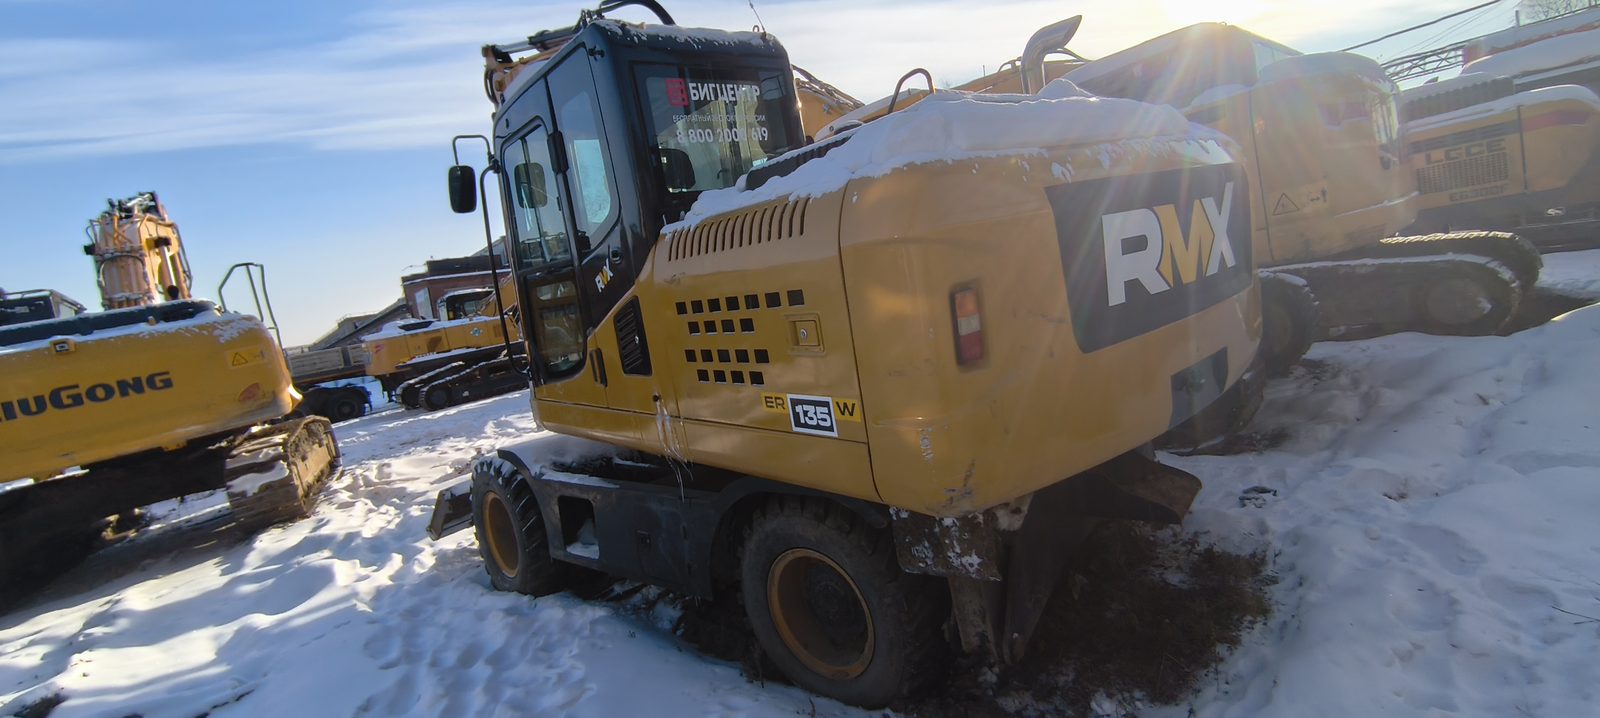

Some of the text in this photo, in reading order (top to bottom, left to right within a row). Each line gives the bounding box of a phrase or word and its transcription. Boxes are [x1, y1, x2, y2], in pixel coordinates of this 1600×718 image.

[688, 82, 760, 103] БИГЦЕНТР
[676, 128, 685, 143] 8
[688, 128, 713, 143] 800
[751, 127, 768, 141] 619
[1425, 138, 1506, 165] LGCE
[1102, 181, 1236, 307] RMX
[595, 258, 613, 293] RMX
[0, 371, 174, 422] IUGONG
[764, 396, 855, 427] ER 135 W
